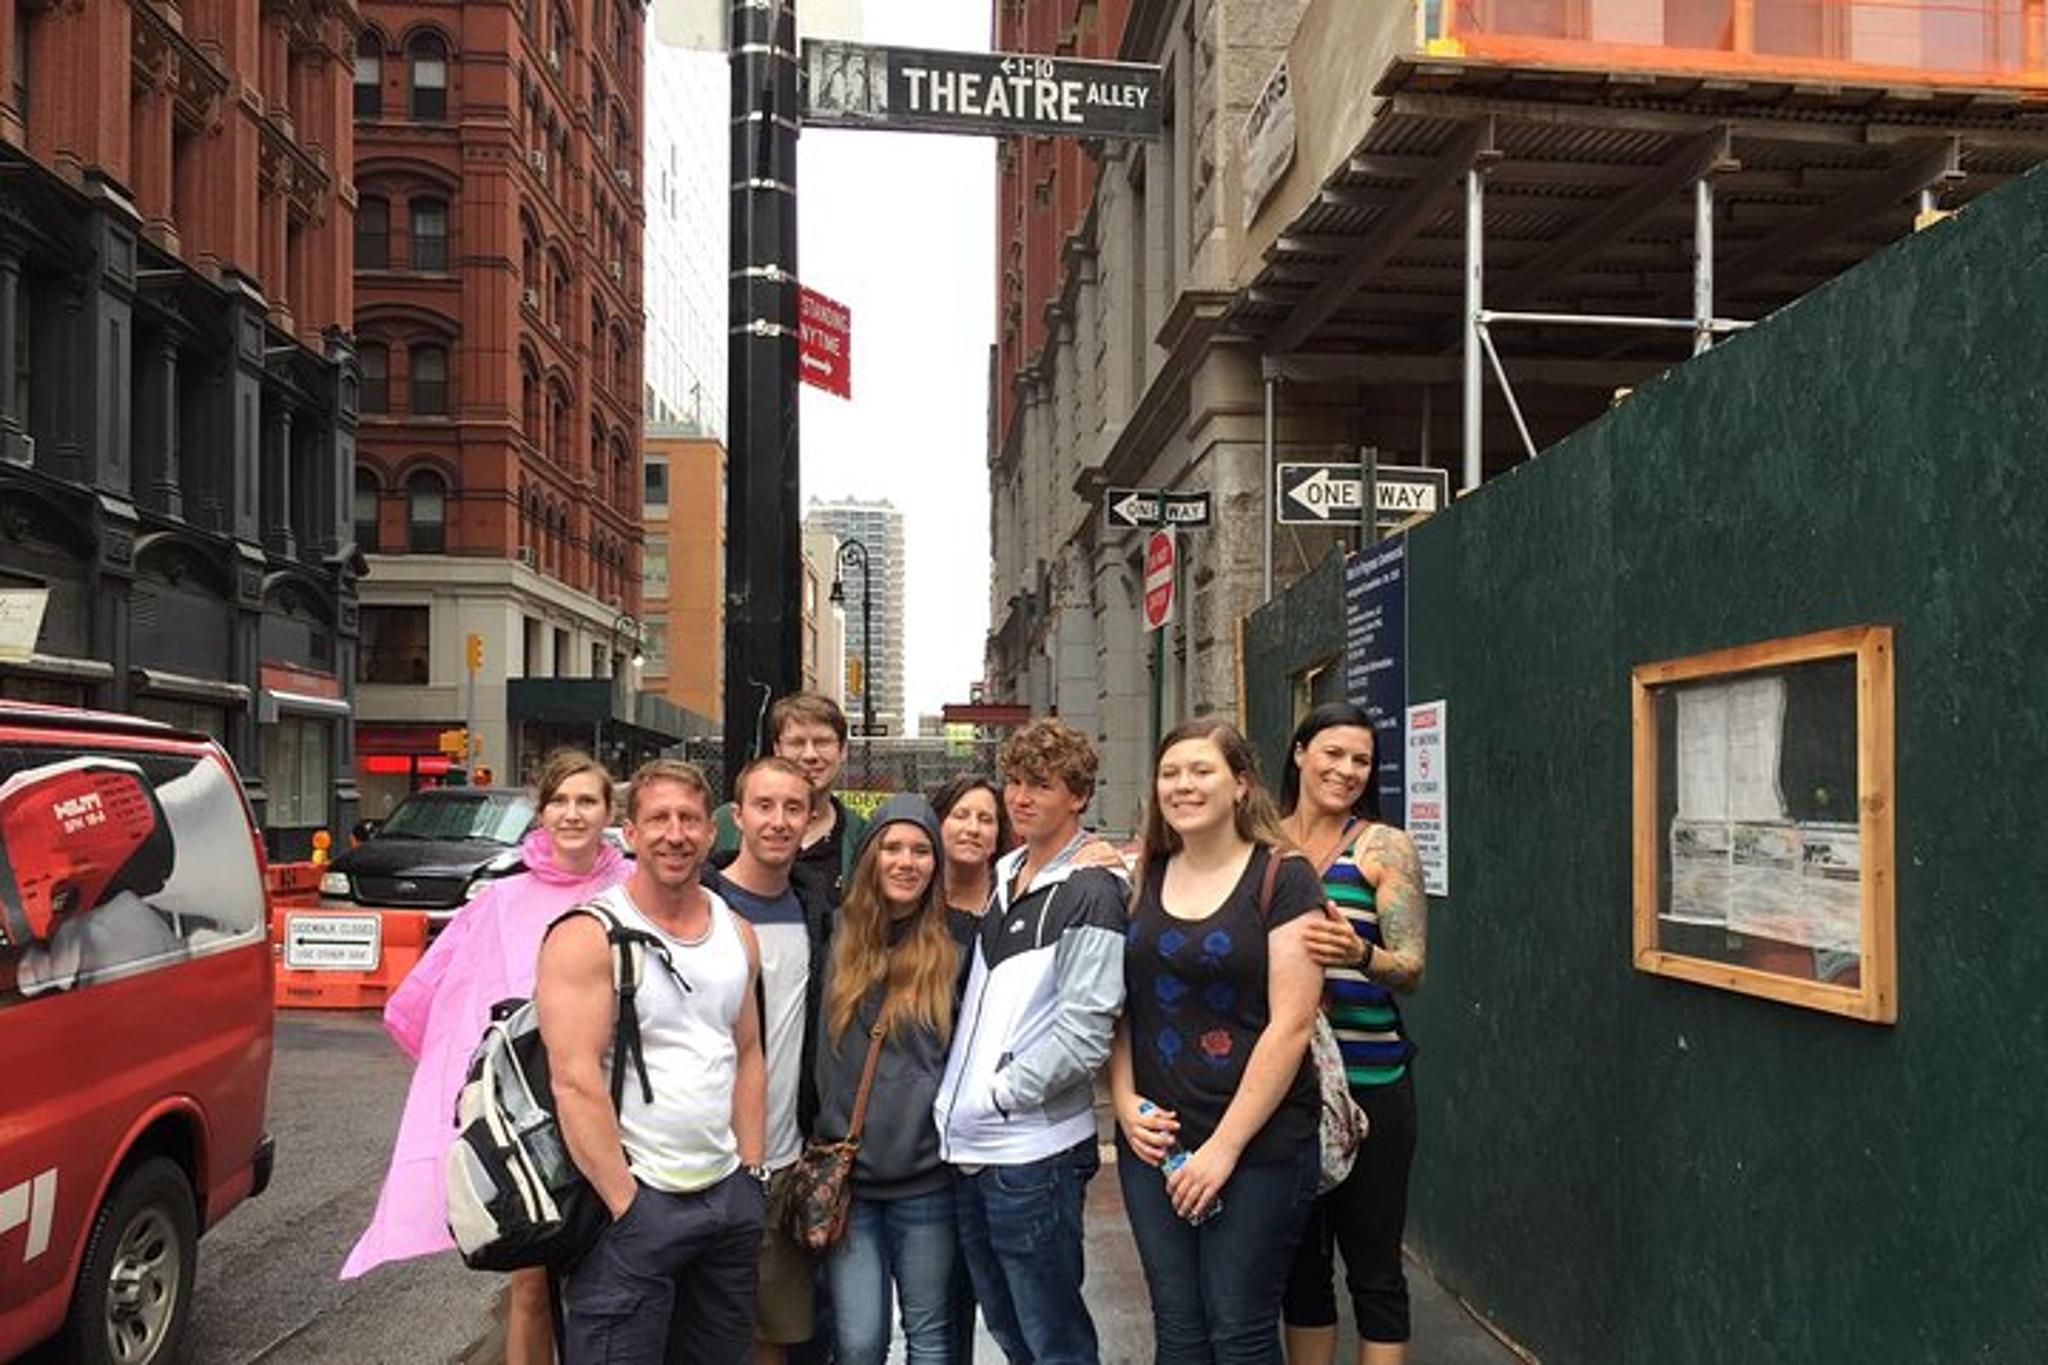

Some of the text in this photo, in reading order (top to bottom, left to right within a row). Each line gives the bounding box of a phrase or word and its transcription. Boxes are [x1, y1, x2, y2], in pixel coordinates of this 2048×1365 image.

[902, 67, 1150, 122] THEATRE ALLEY
[1307, 482, 1427, 508] ONE WAY
[1126, 500, 1200, 520] ONE WAY
[291, 922, 375, 937] SIDEWALK CLOSED
